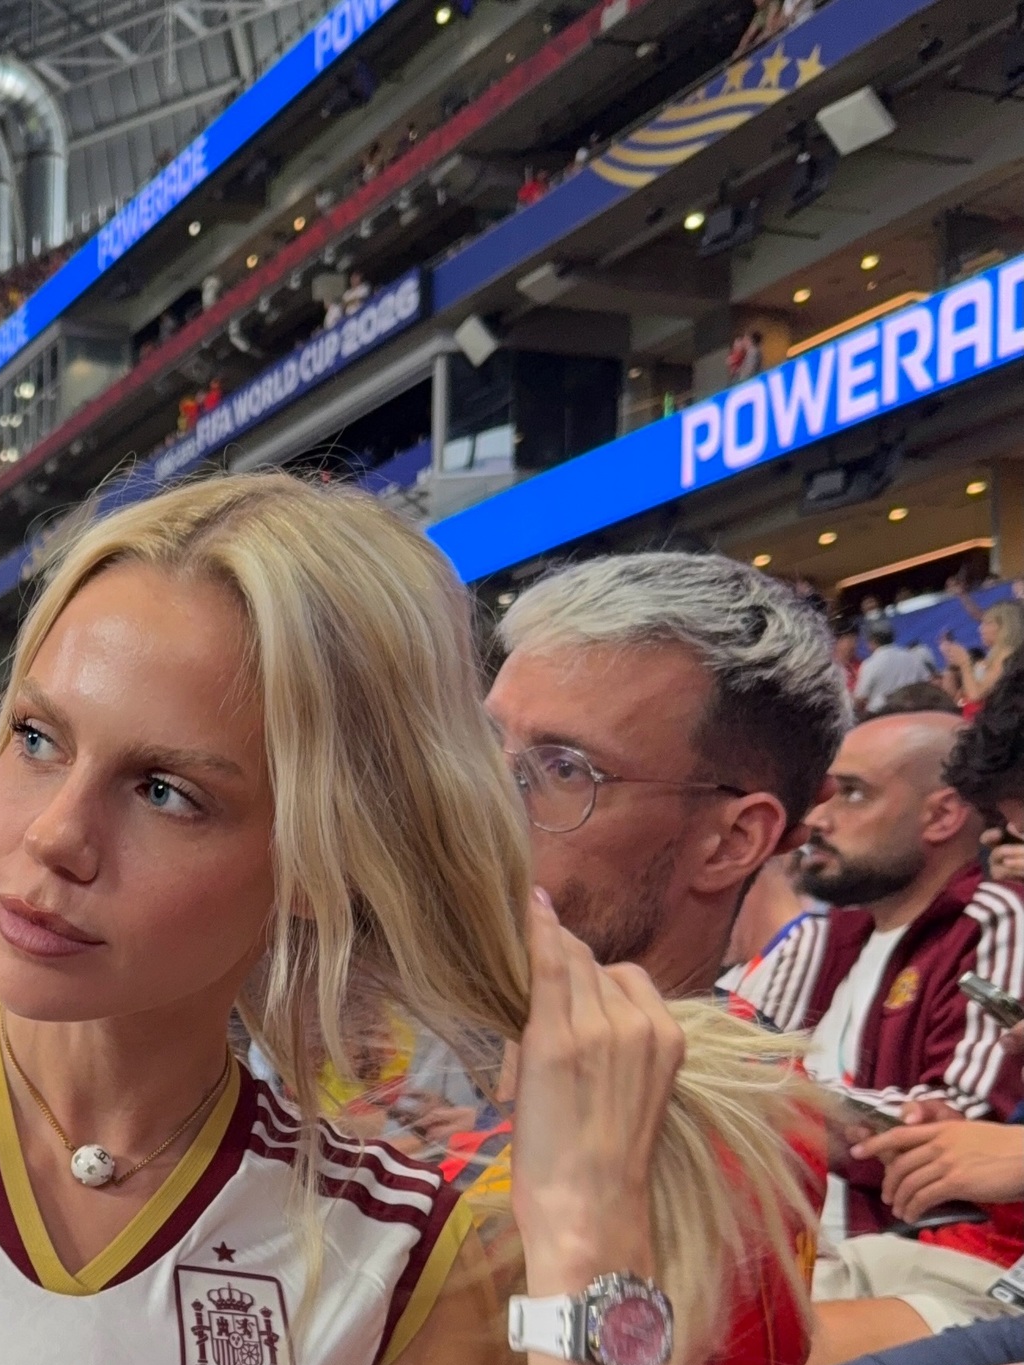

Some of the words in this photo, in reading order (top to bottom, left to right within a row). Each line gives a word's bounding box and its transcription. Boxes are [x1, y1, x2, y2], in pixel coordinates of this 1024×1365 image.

[314, 0, 397, 71] POW
[97, 134, 208, 272] POWERADE
[196, 403, 234, 448] FIFA
[232, 361, 299, 428] WORLD
[299, 332, 341, 382] CUP
[341, 277, 420, 358] 2026
